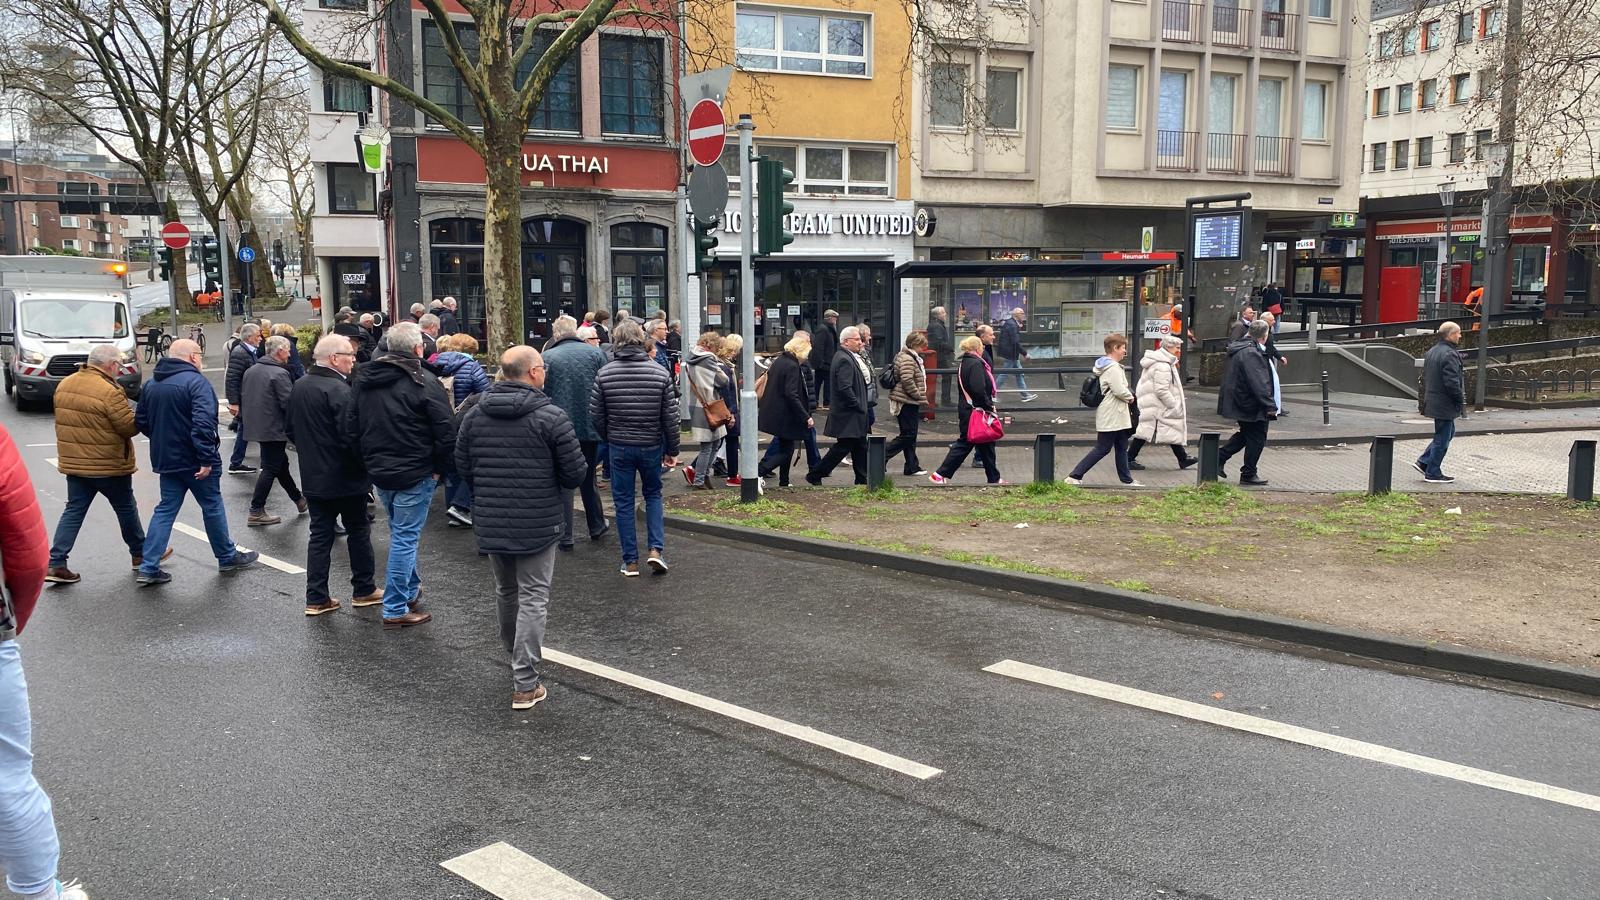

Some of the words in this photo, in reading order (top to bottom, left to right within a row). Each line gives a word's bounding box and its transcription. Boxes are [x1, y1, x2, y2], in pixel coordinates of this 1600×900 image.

[519, 153, 554, 171] UA
[558, 154, 608, 174] THAI
[724, 210, 758, 233] IC
[783, 212, 834, 234] EAM
[841, 213, 913, 235] UNITED
